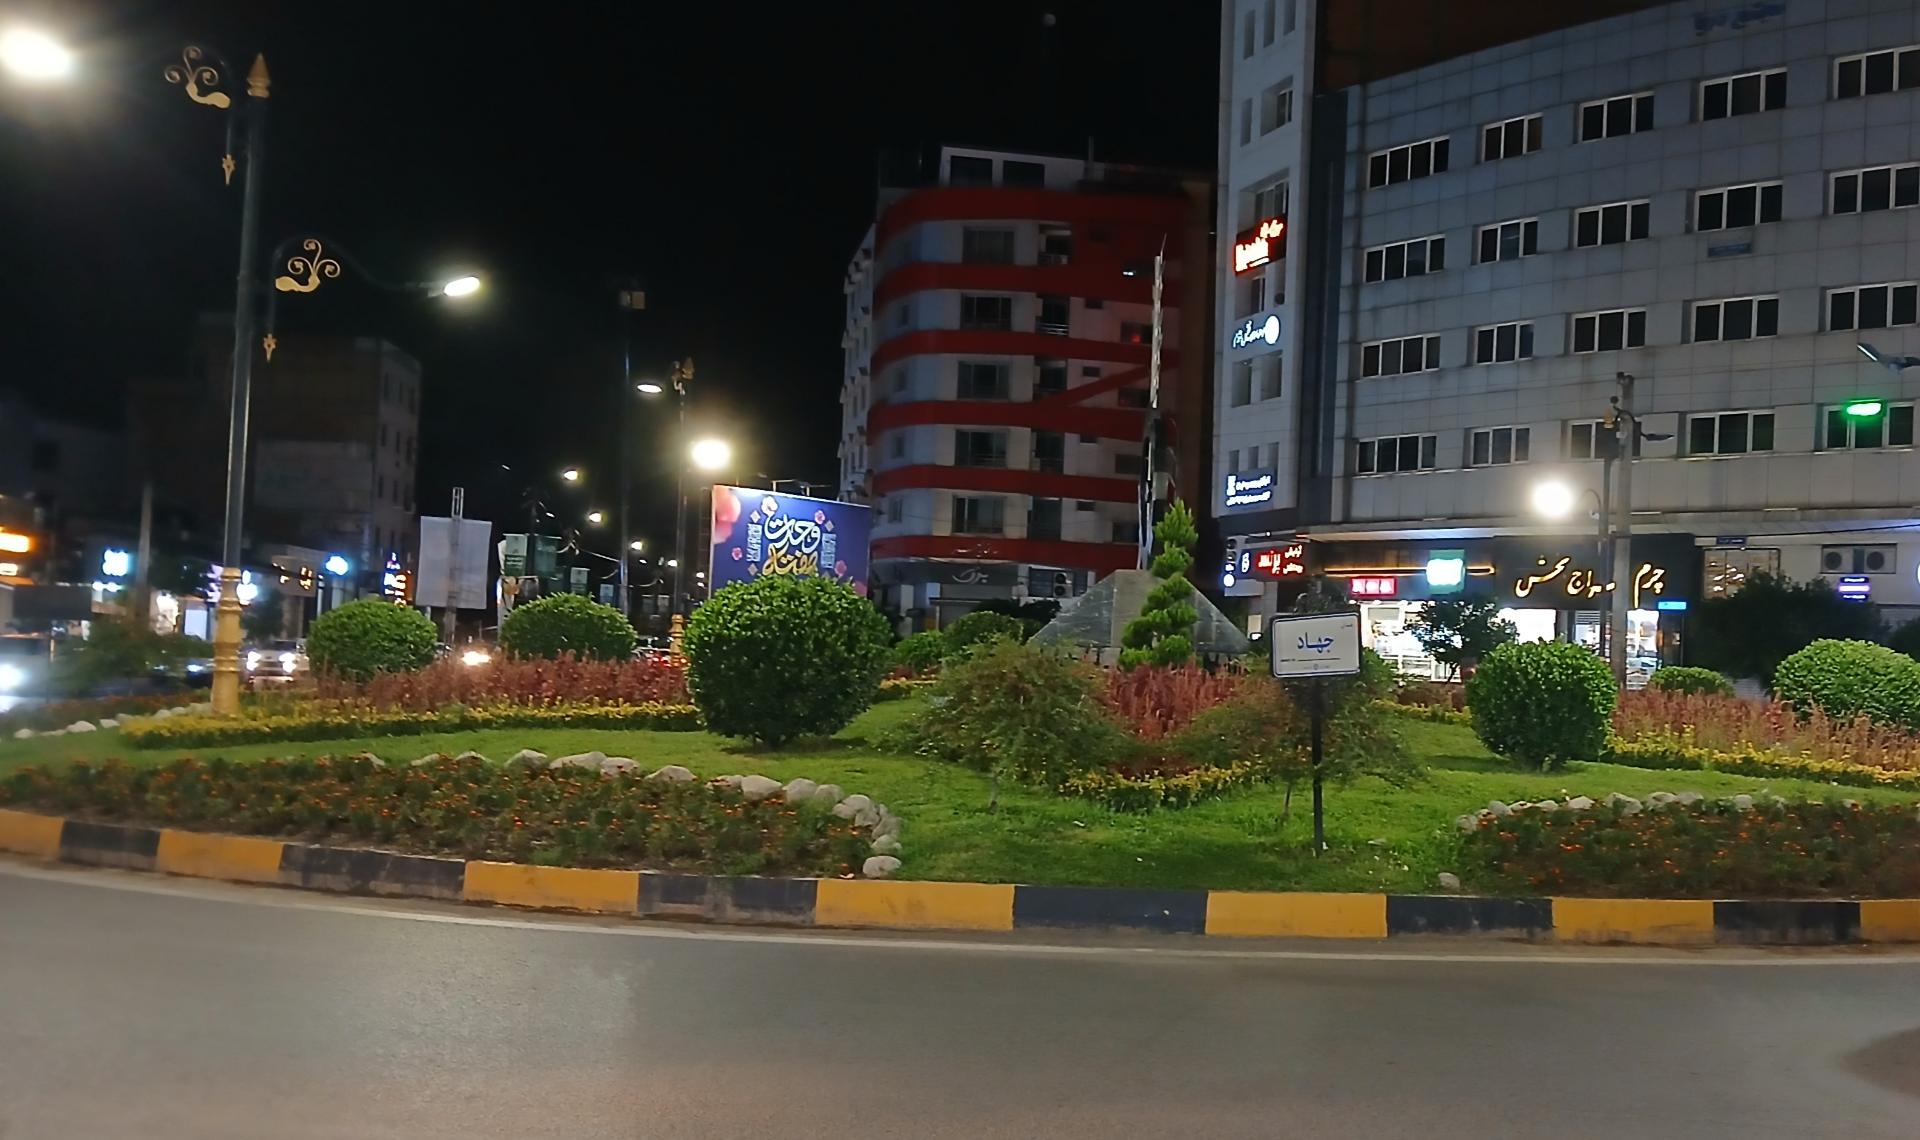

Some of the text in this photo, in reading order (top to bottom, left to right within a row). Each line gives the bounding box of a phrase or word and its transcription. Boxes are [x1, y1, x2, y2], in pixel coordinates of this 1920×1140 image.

[764, 513, 821, 554] وحدت
[1634, 563, 1665, 609] چرم
[1297, 631, 1335, 654] جهاد
